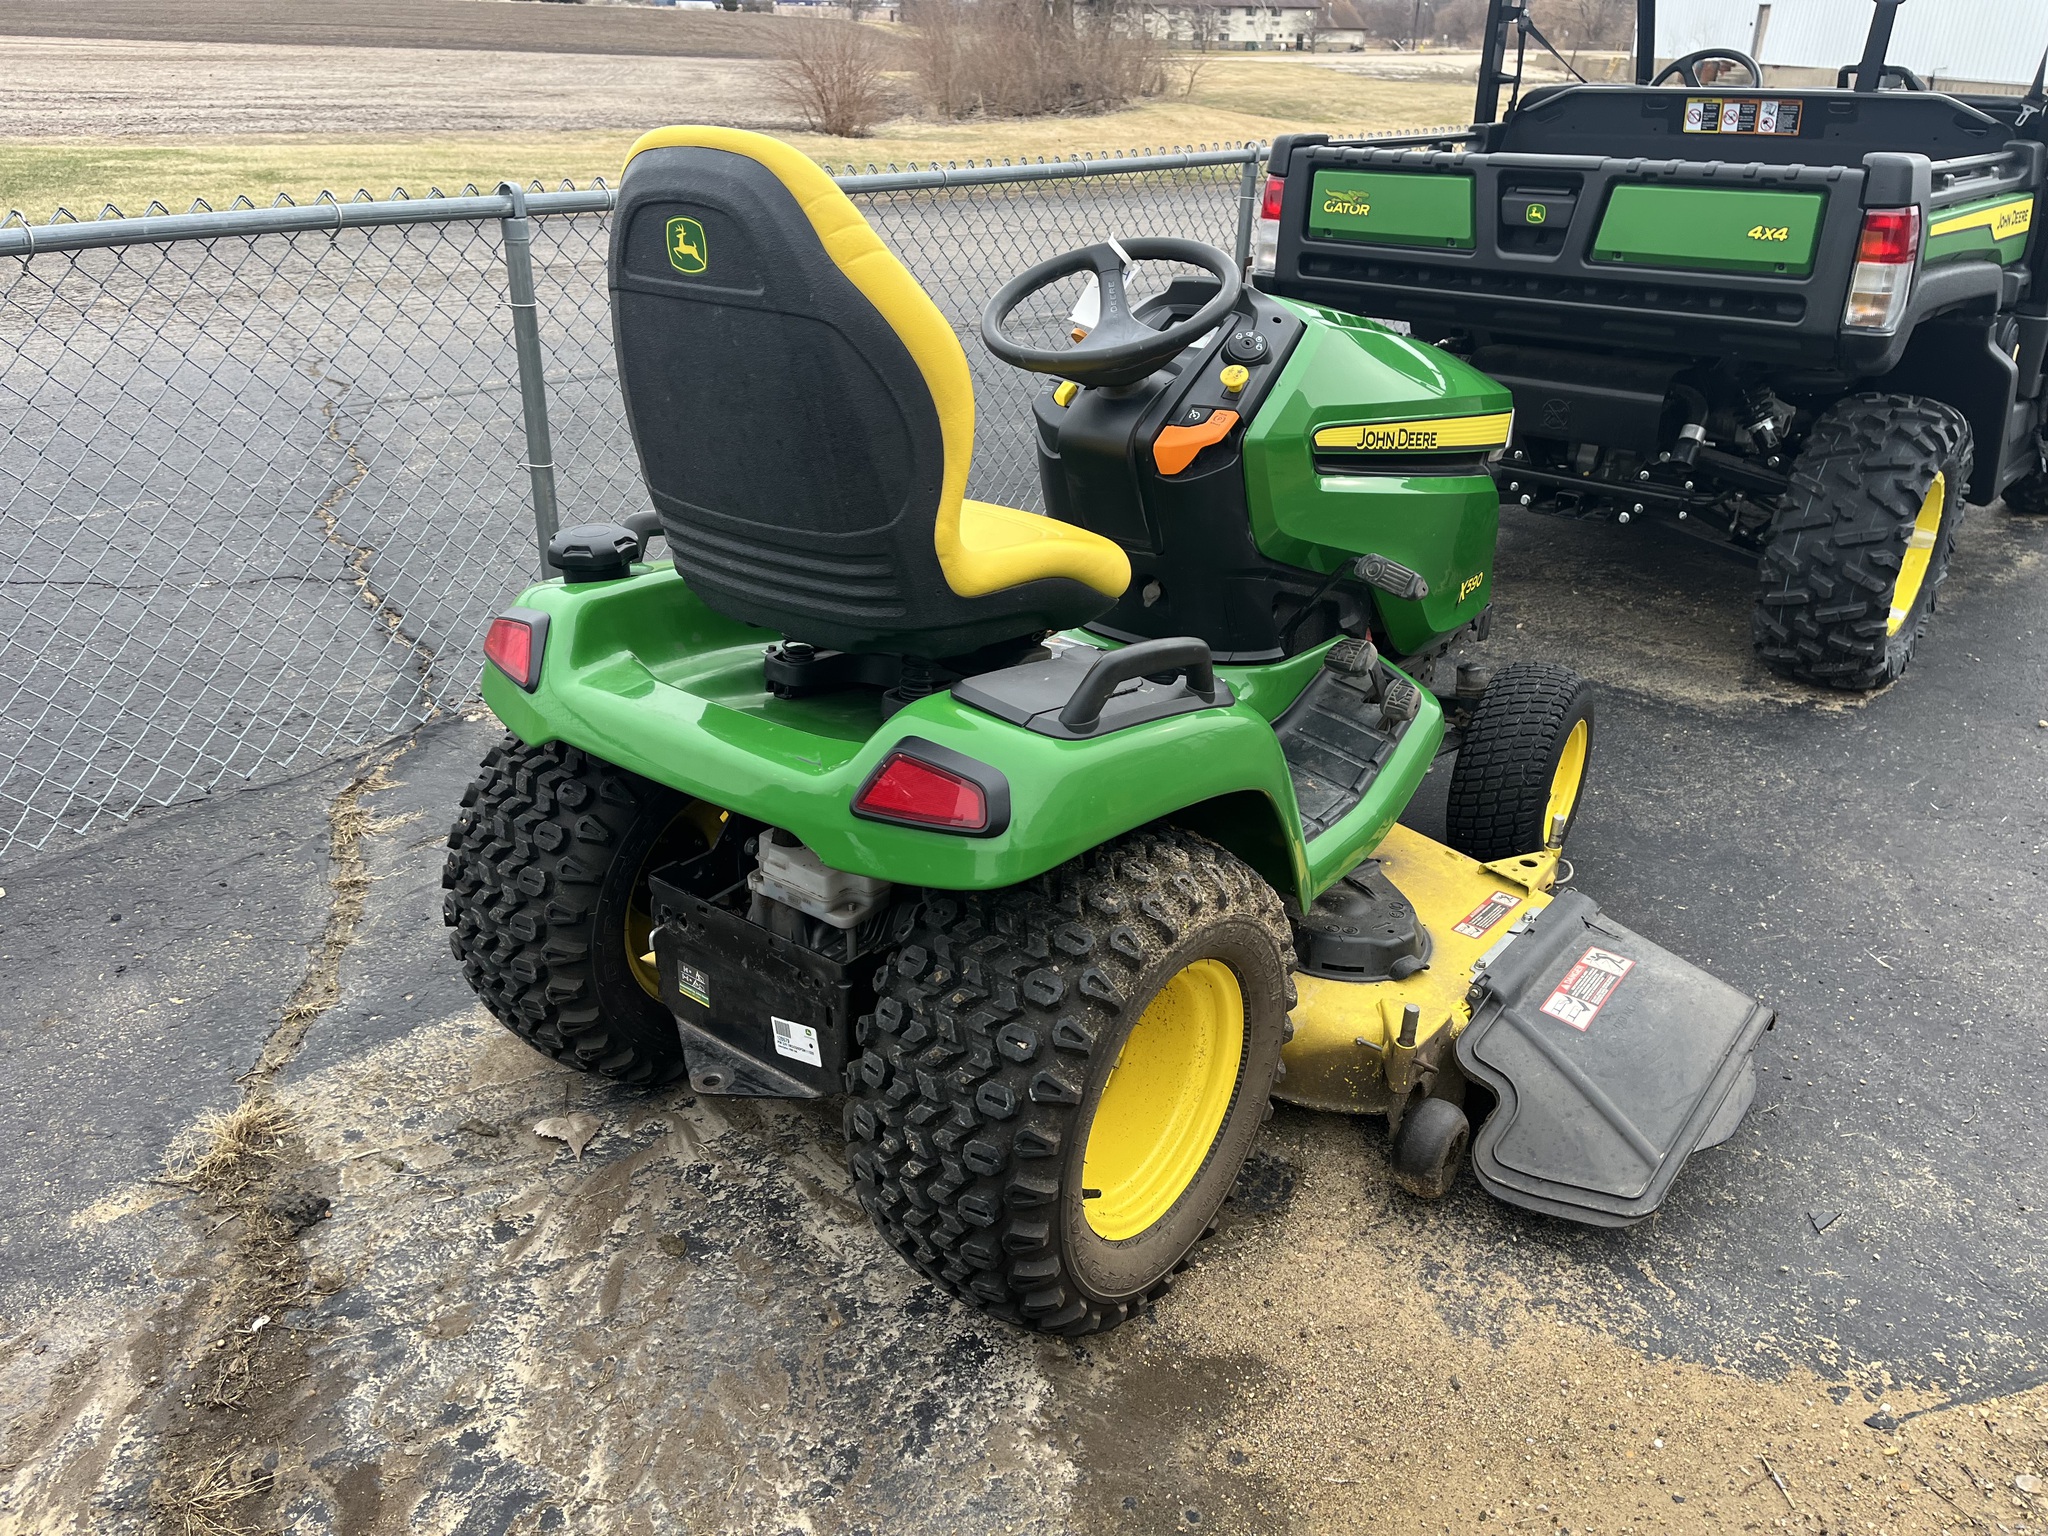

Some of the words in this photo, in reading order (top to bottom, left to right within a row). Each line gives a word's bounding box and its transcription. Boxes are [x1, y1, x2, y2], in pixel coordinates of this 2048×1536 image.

[1323, 199, 1371, 216] GATOR
[1997, 213, 2011, 230] JOHN
[2011, 209, 2029, 225] DEERE
[1356, 427, 1395, 449] JOHN
[1397, 428, 1438, 449] DEERE
[1457, 571, 1483, 603] X590
[1563, 964, 1585, 985] DANGER
